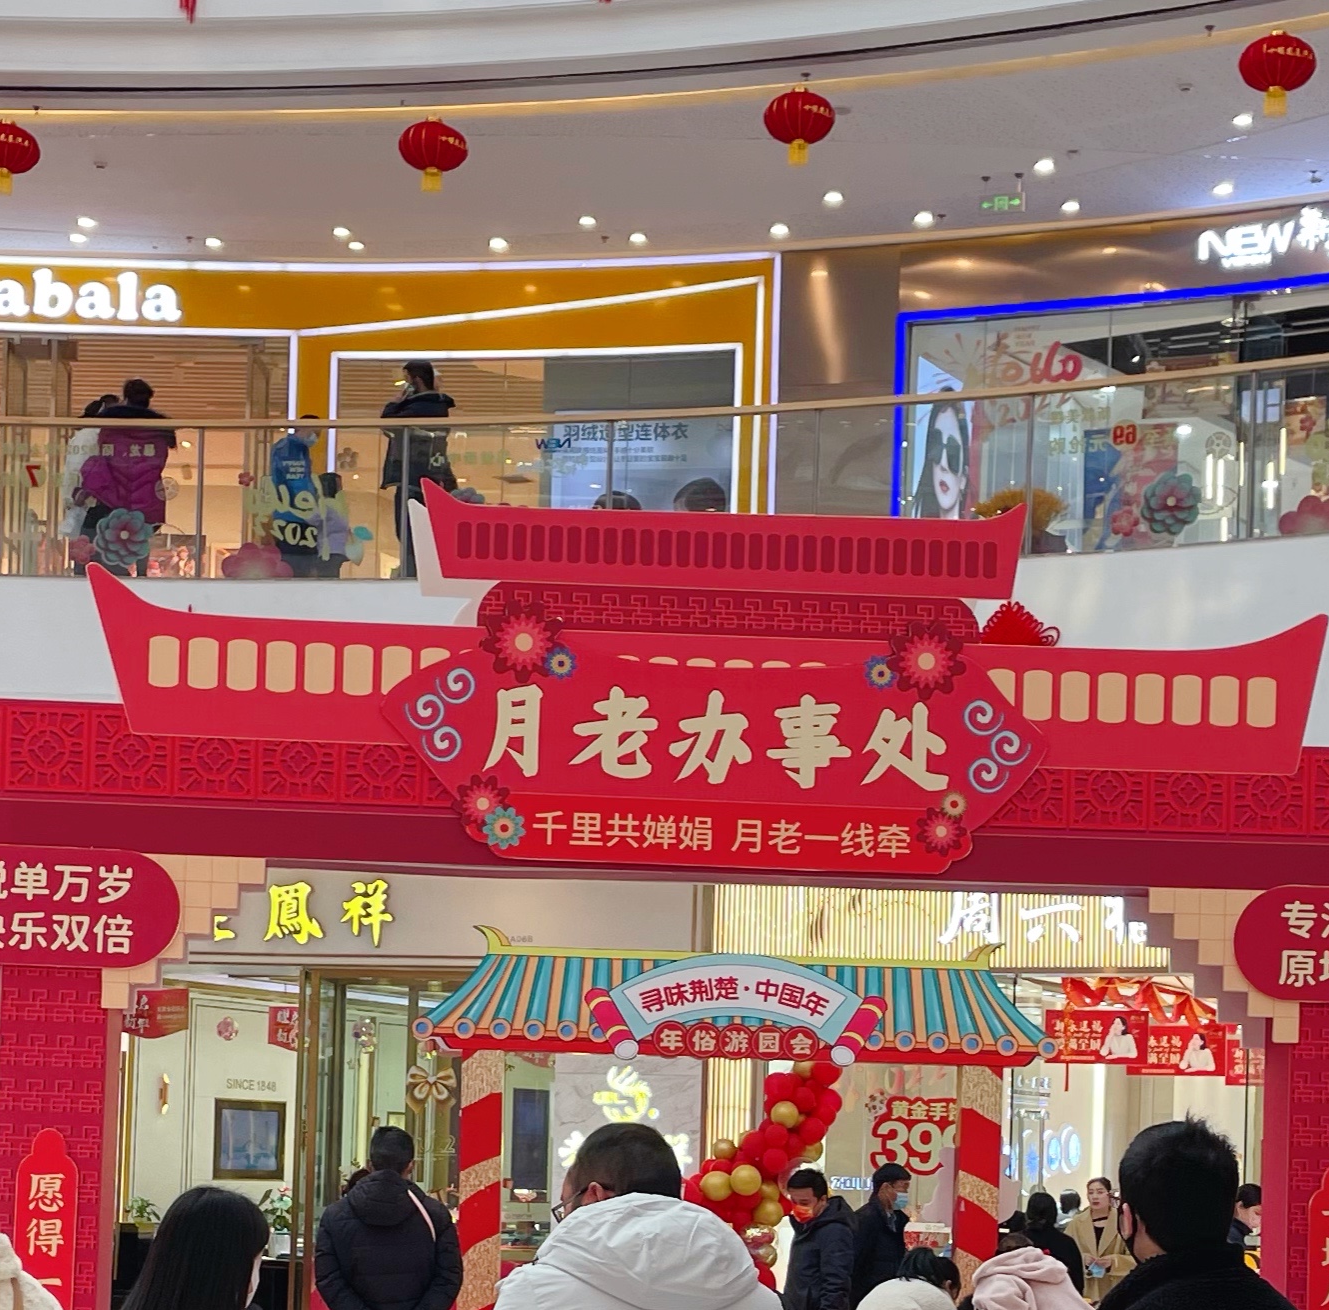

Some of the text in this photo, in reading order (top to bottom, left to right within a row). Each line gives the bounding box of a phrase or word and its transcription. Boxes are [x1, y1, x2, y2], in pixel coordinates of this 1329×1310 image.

[1198, 222, 1295, 262] NEW
[482, 683, 949, 792] 月老办事处
[531, 811, 912, 858] 千里共婵娟 月老一线牵
[214, 879, 394, 947] 鳳祥
[659, 1029, 816, 1058] 年俗游园会
[226, 1078, 277, 1092] SINCE 1848
[26, 1172, 65, 1288] 愿得一
